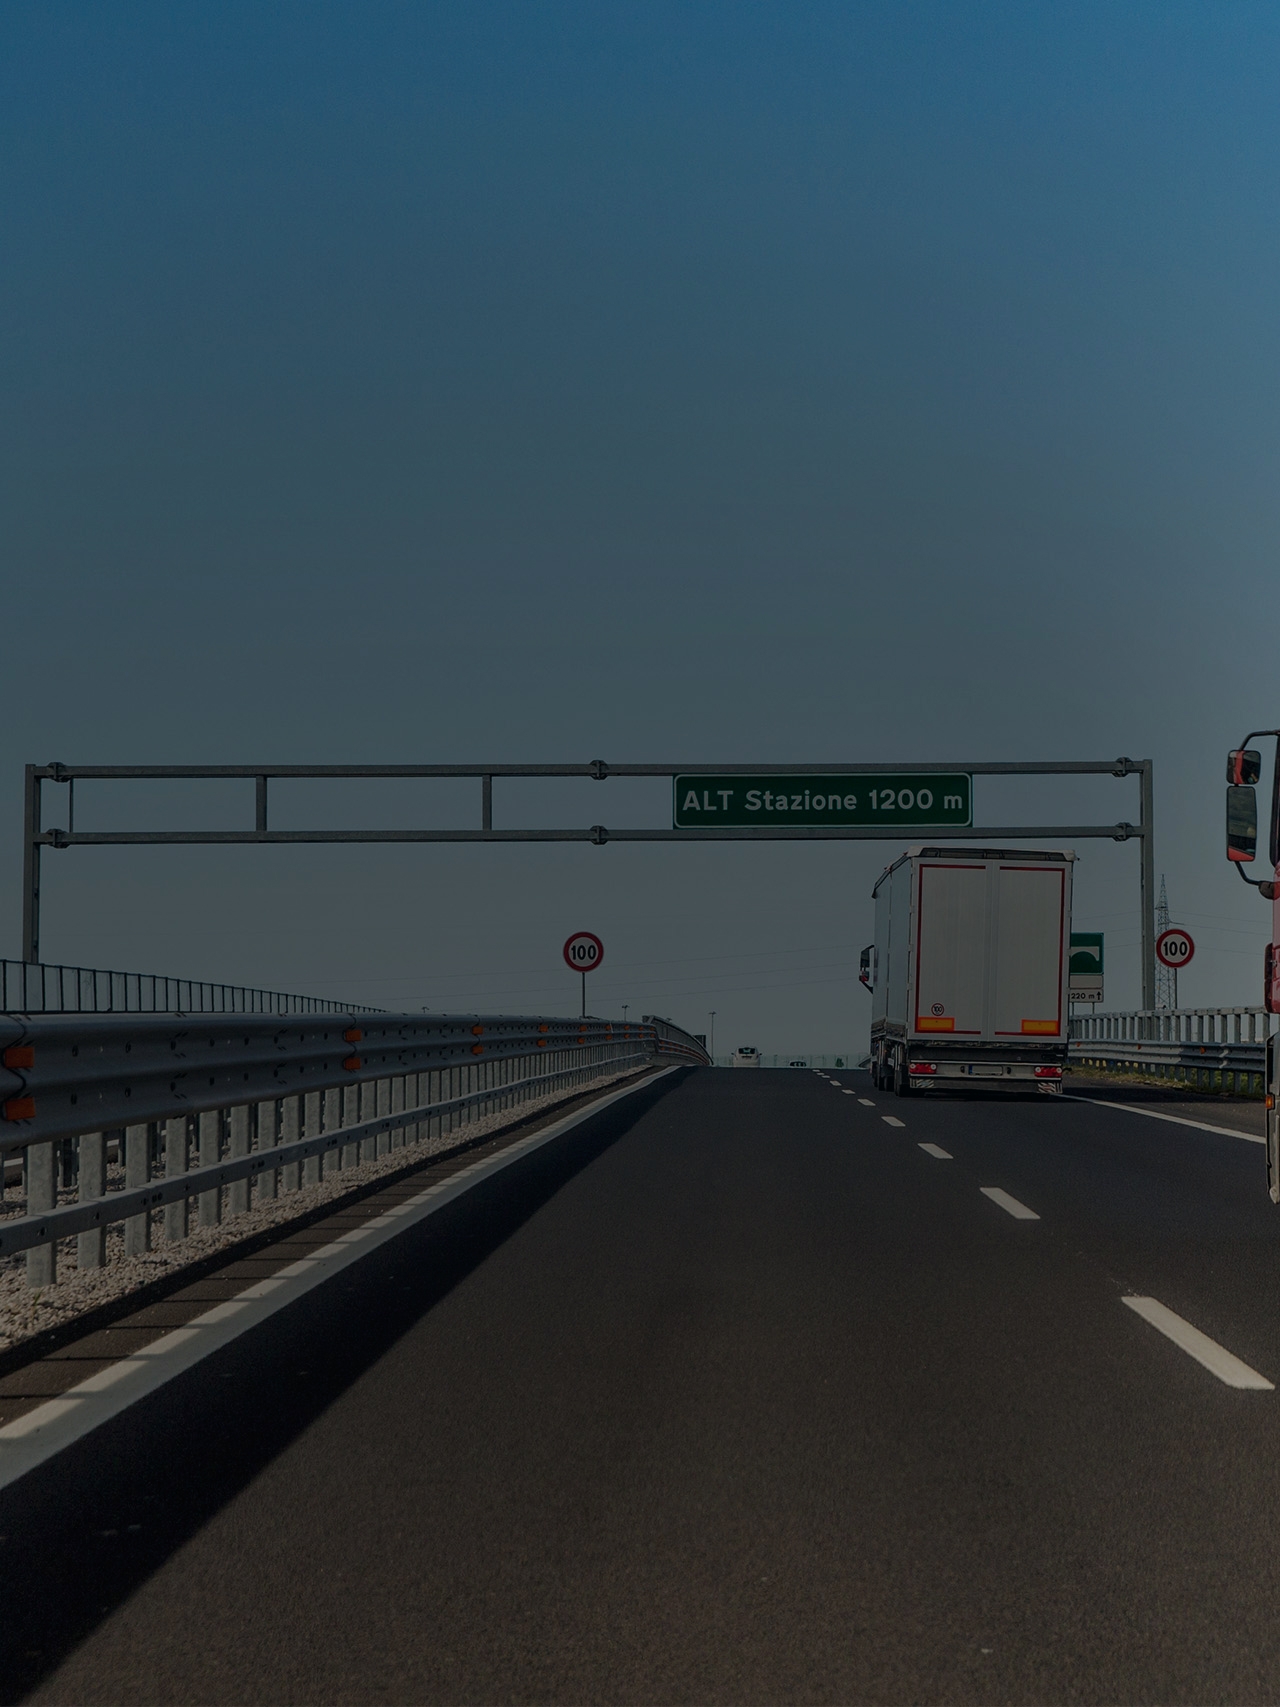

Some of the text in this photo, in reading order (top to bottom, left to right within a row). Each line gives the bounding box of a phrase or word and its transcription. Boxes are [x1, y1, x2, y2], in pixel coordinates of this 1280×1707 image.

[682, 789, 963, 811] ALT Stazione 1200 m
[571, 945, 597, 960] 100
[1163, 941, 1188, 956] 100
